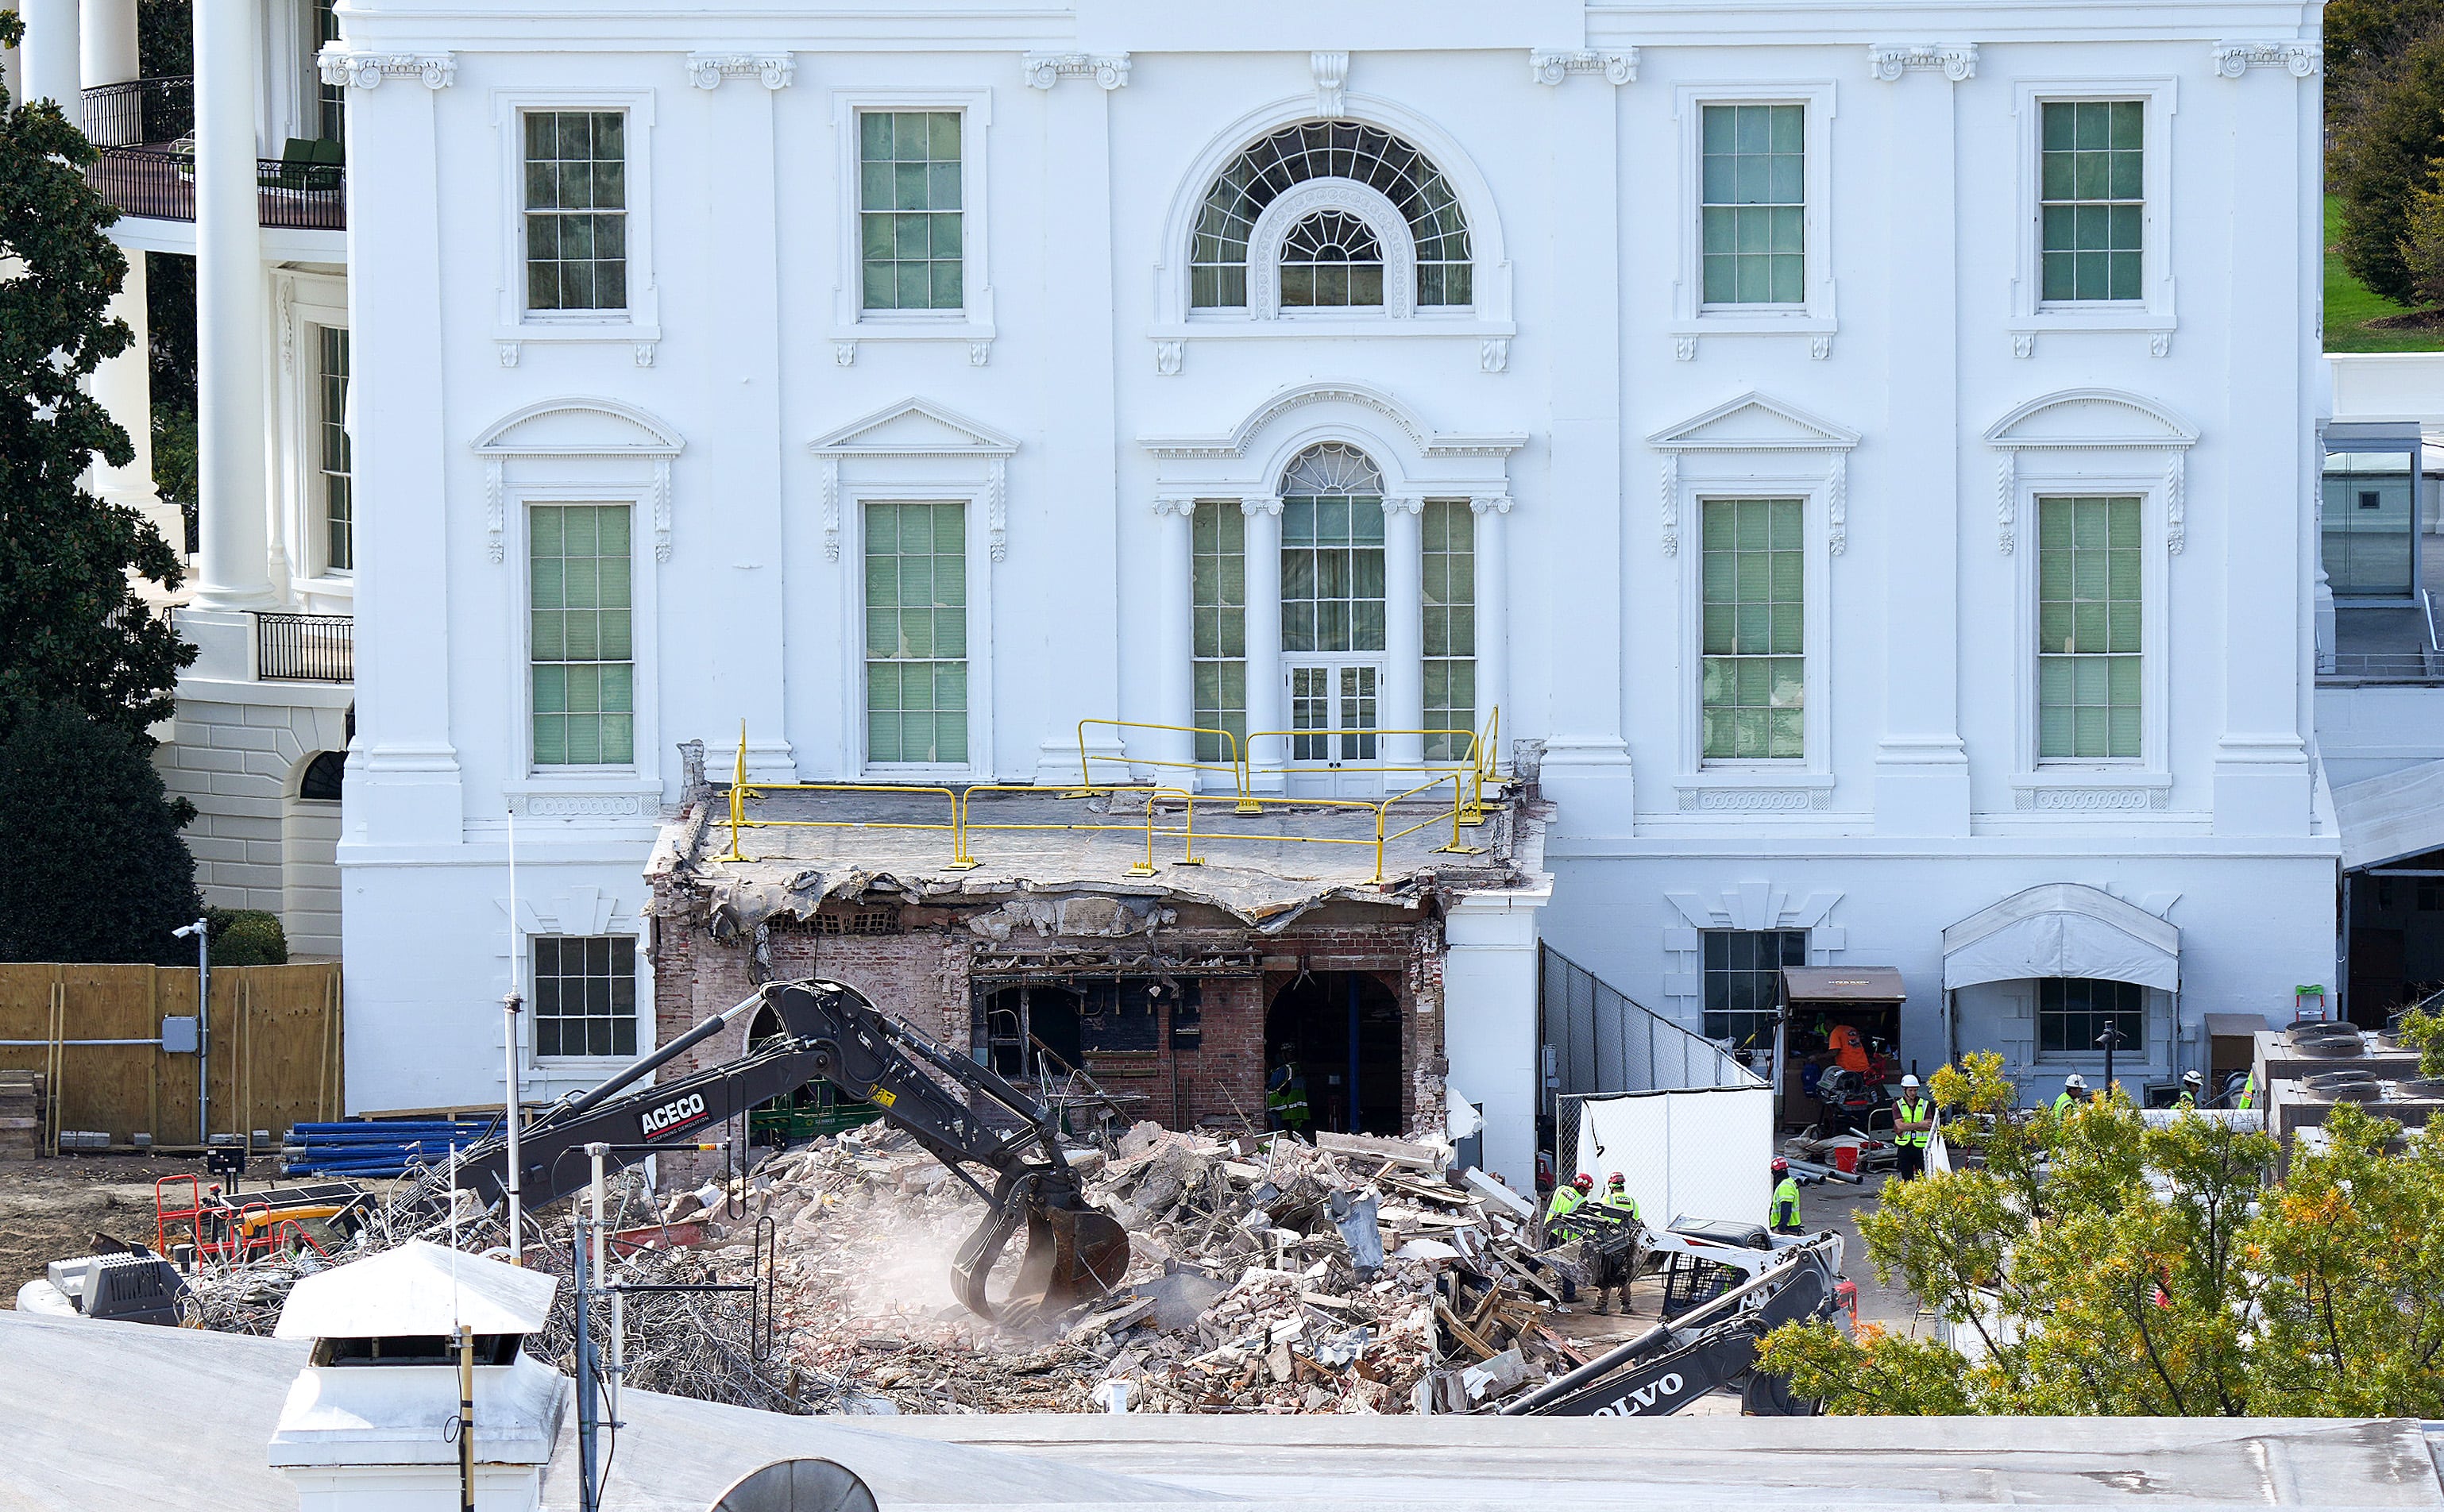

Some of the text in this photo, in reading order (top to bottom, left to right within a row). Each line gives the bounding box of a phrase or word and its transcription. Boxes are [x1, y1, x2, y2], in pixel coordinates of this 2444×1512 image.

[642, 1094, 705, 1134] ACECO
[647, 1116, 710, 1144] REDEFINING DEMOLITION
[1589, 1372, 1684, 1417] LVO
